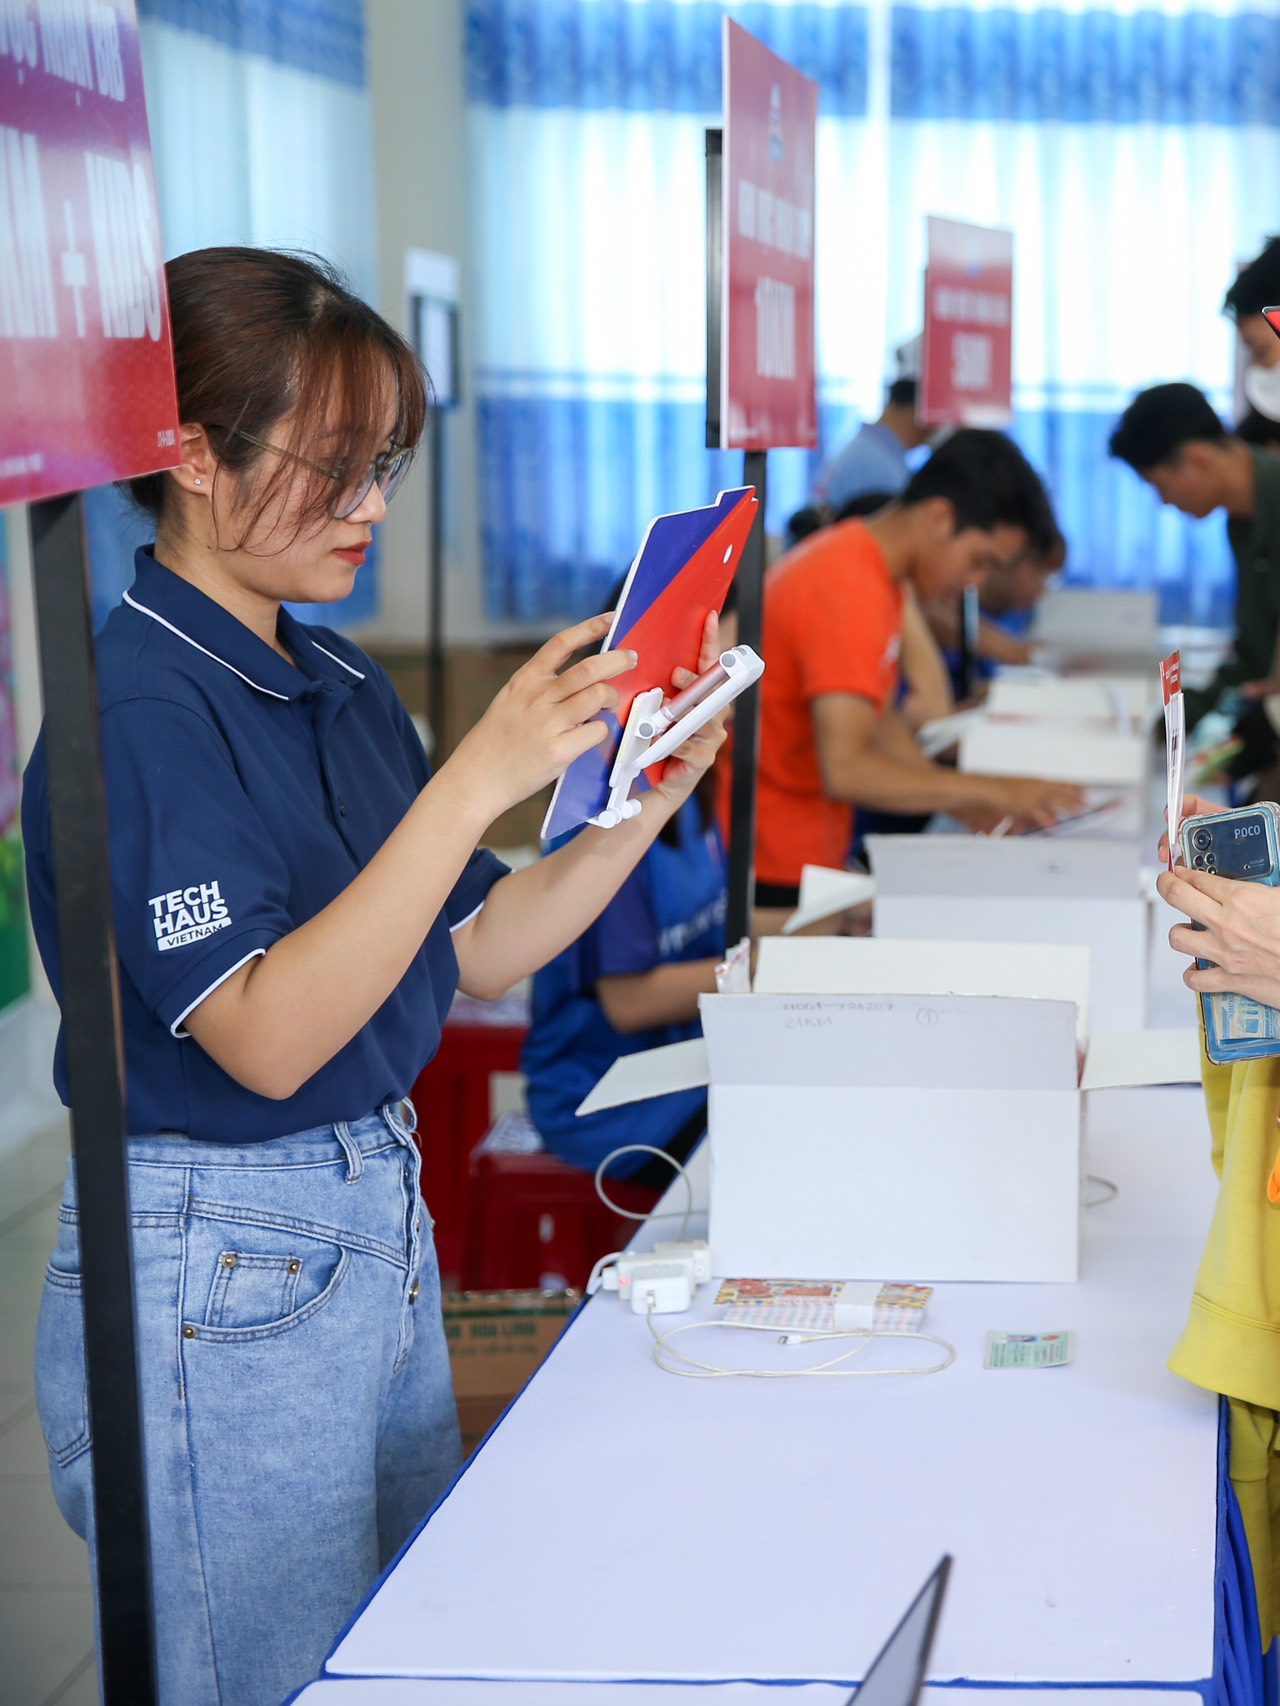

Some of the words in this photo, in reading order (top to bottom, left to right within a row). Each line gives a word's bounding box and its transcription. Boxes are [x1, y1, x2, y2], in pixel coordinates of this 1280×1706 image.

[1234, 825, 1261, 839] POCO
[149, 881, 220, 917] TECH
[153, 899, 229, 938] HAUS
[167, 923, 222, 946] VIETNAM
